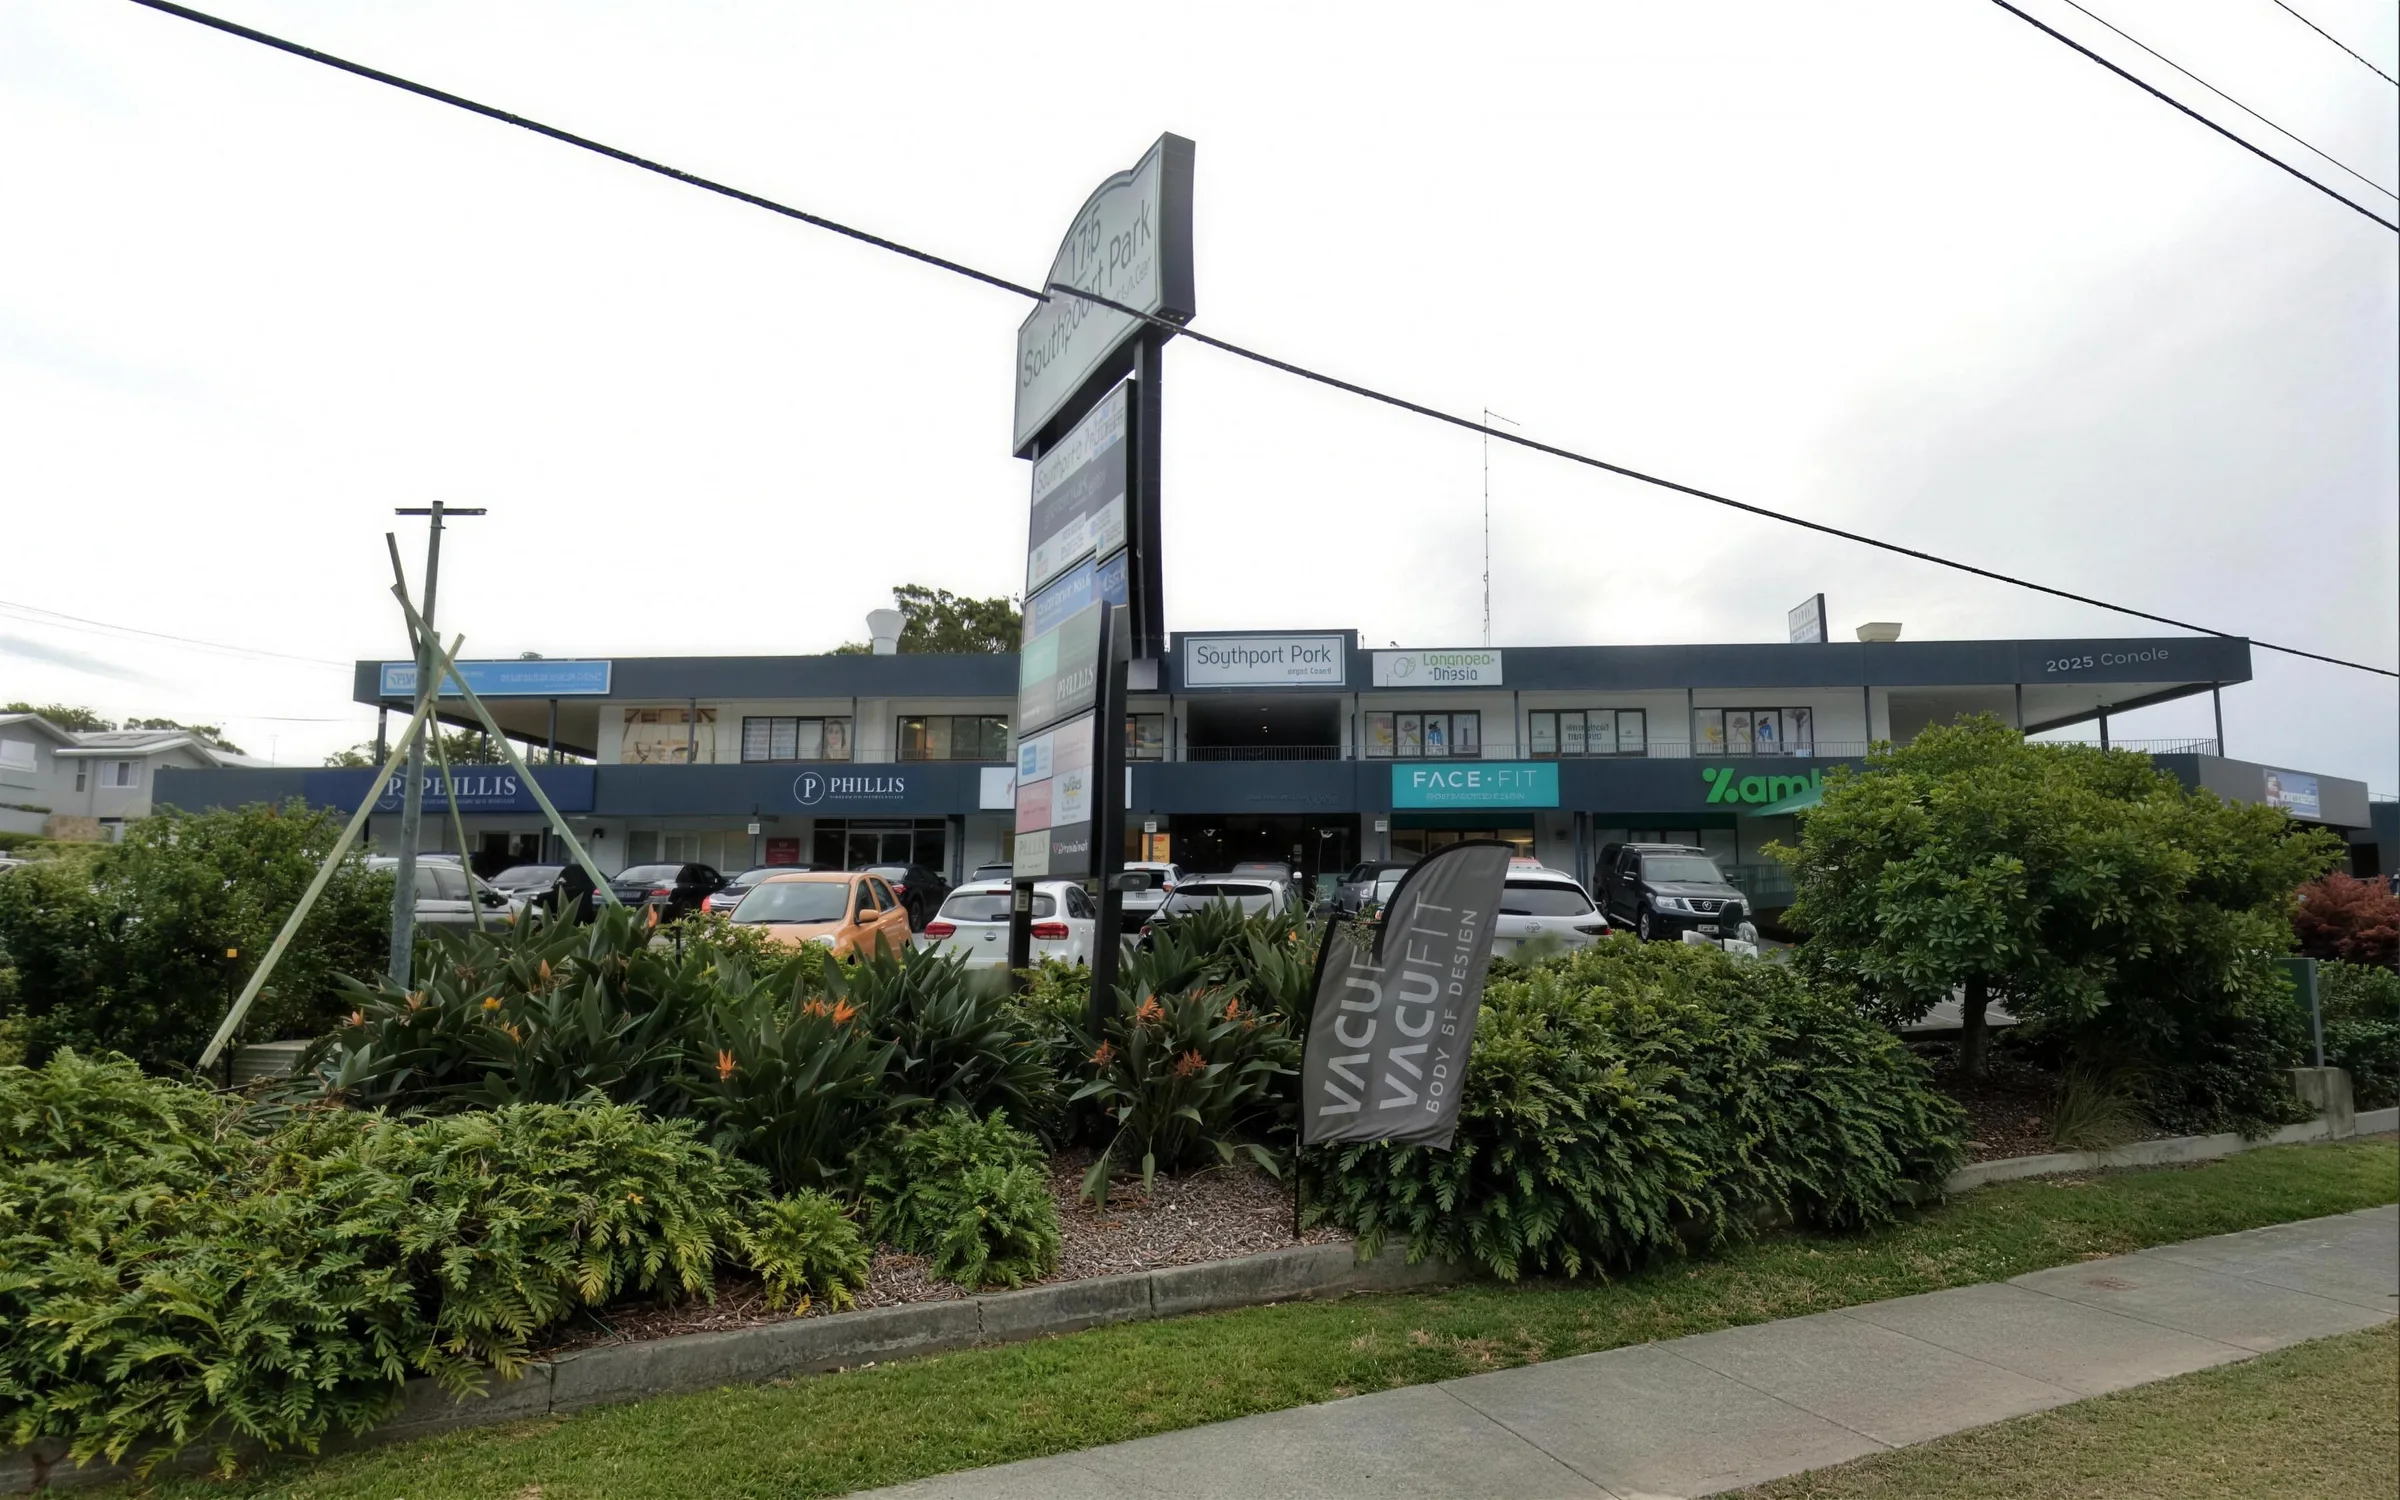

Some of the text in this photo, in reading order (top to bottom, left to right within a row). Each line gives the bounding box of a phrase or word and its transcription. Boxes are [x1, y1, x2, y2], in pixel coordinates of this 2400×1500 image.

[1109, 198, 1152, 288] Park
[2046, 656, 2094, 672] 2025
[830, 777, 905, 793] PHILLIS
[1413, 770, 1537, 788] FACE FIT
[1448, 909, 1478, 996] DESIGN
[1378, 890, 1453, 1110] VACUFIT
